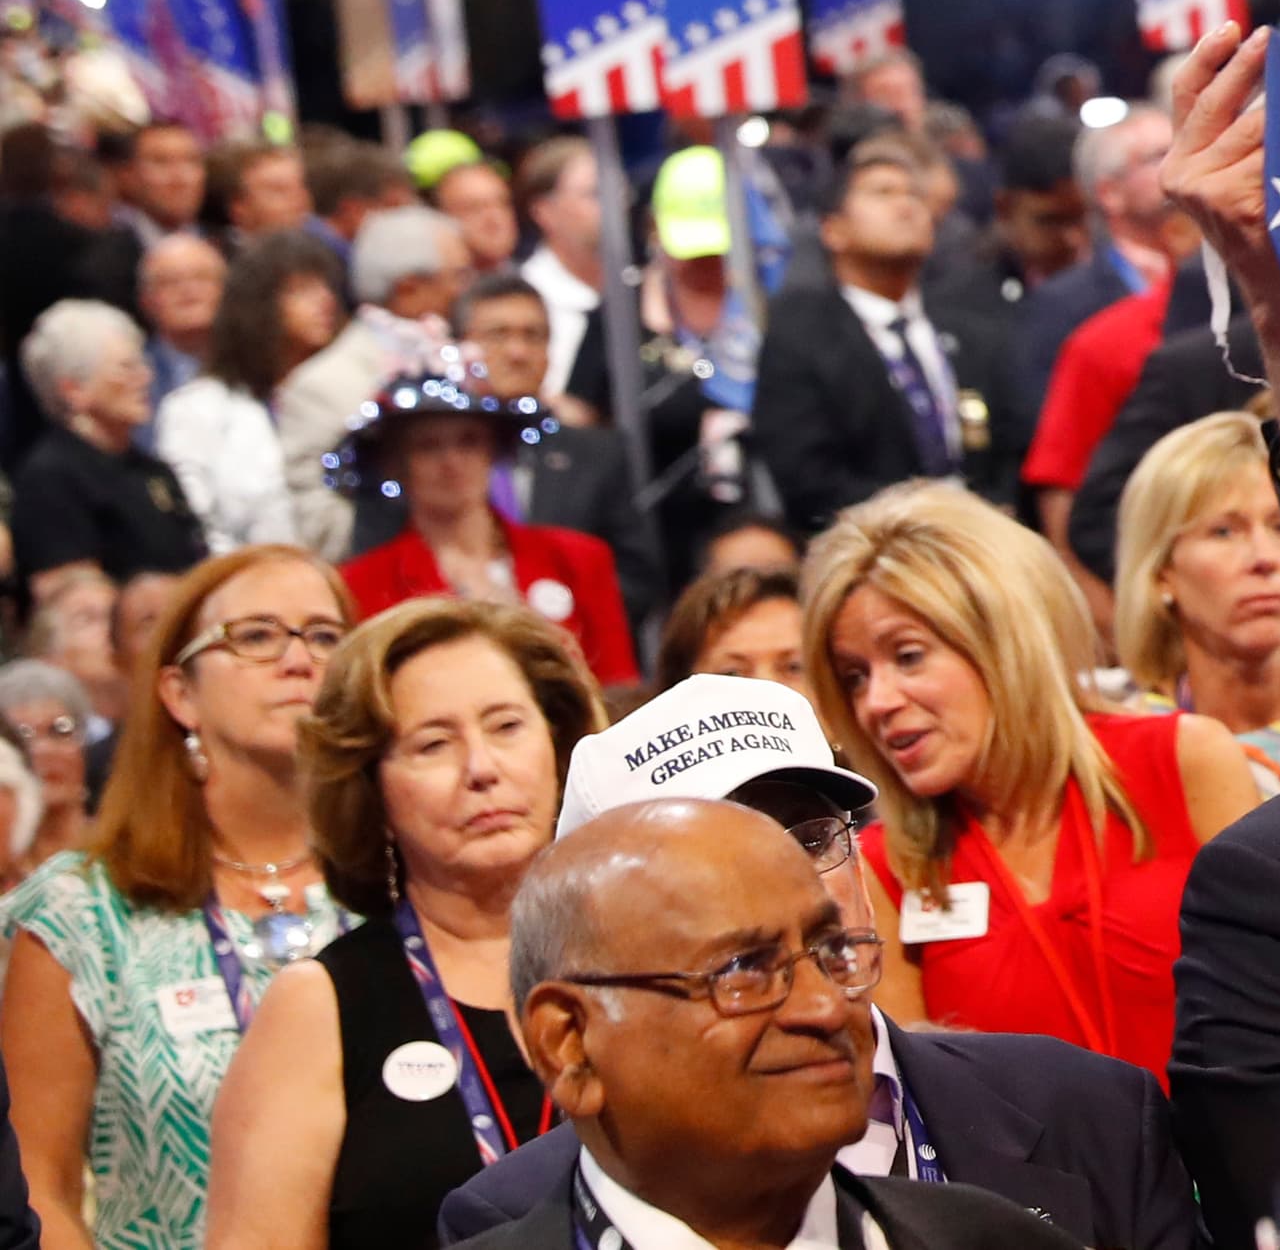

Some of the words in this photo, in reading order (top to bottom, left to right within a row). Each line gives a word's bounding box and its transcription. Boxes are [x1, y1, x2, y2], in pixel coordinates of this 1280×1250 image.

[624, 724, 693, 771] MAKE
[697, 710, 796, 735] AMERICA
[650, 739, 724, 785] GREAT
[730, 733, 793, 754] AGAIN
